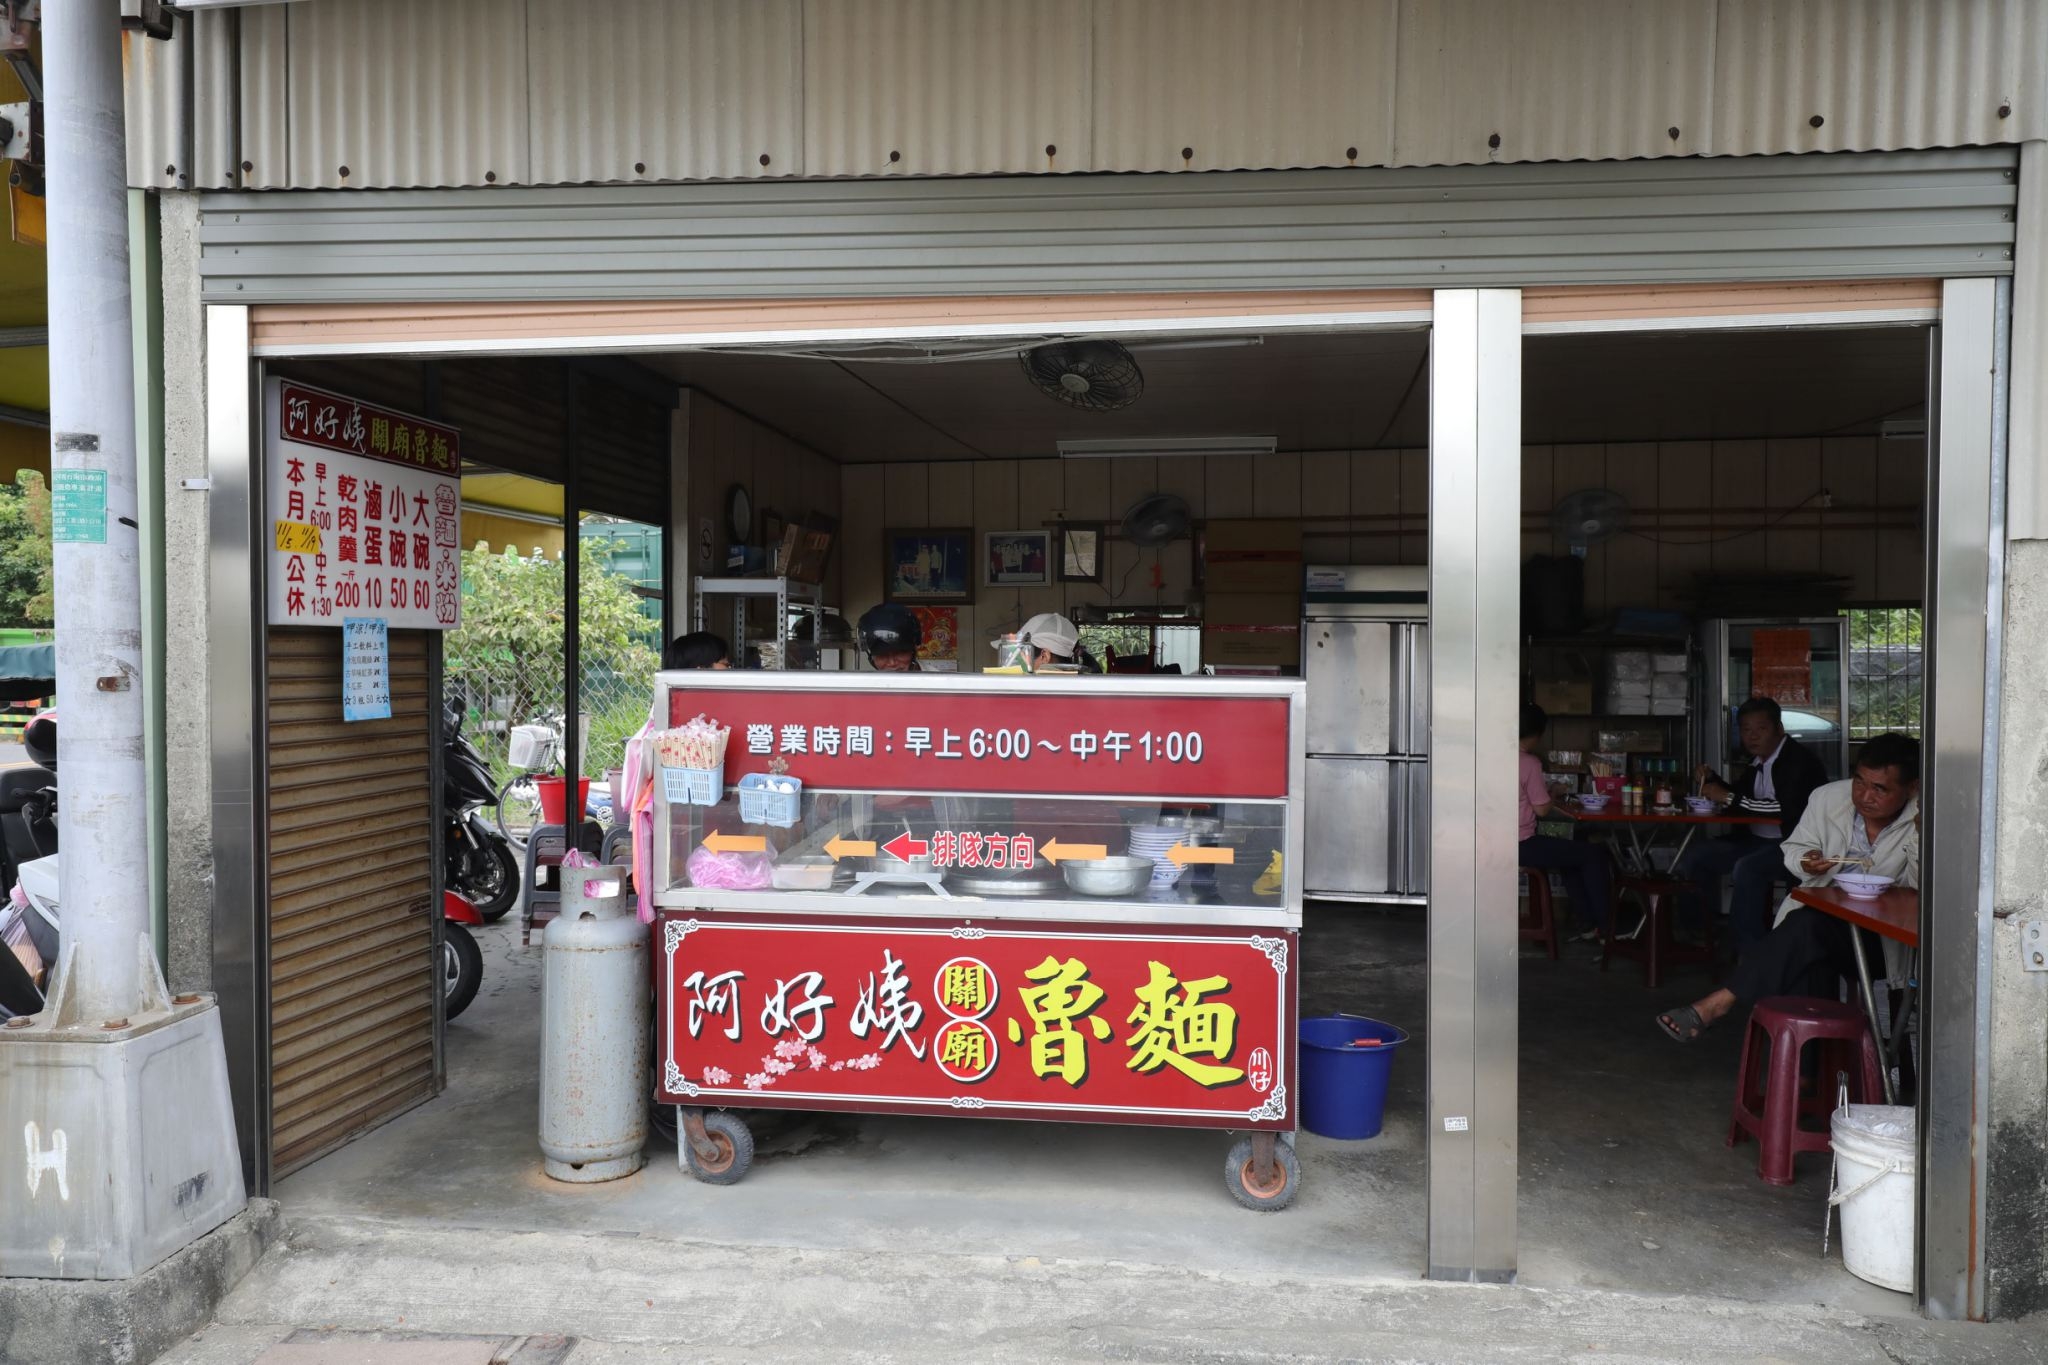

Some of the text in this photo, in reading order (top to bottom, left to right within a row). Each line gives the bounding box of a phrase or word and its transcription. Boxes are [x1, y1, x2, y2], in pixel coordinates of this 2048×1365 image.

[288, 397, 367, 455] 阿好姨
[286, 457, 306, 521] 本月
[337, 473, 358, 564] 乾肉羹
[363, 479, 383, 609] 滷蛋 10
[389, 484, 408, 610] 小碗 50
[412, 489, 431, 610] 大碗 60
[286, 554, 306, 617] 公休
[335, 580, 360, 608] 200
[932, 830, 1035, 869] 排隊方向
[682, 948, 1245, 1086] 阿好姨 關廟 魯麵
[1250, 1051, 1271, 1091] 川仔
[24, 1120, 70, 1202] H
